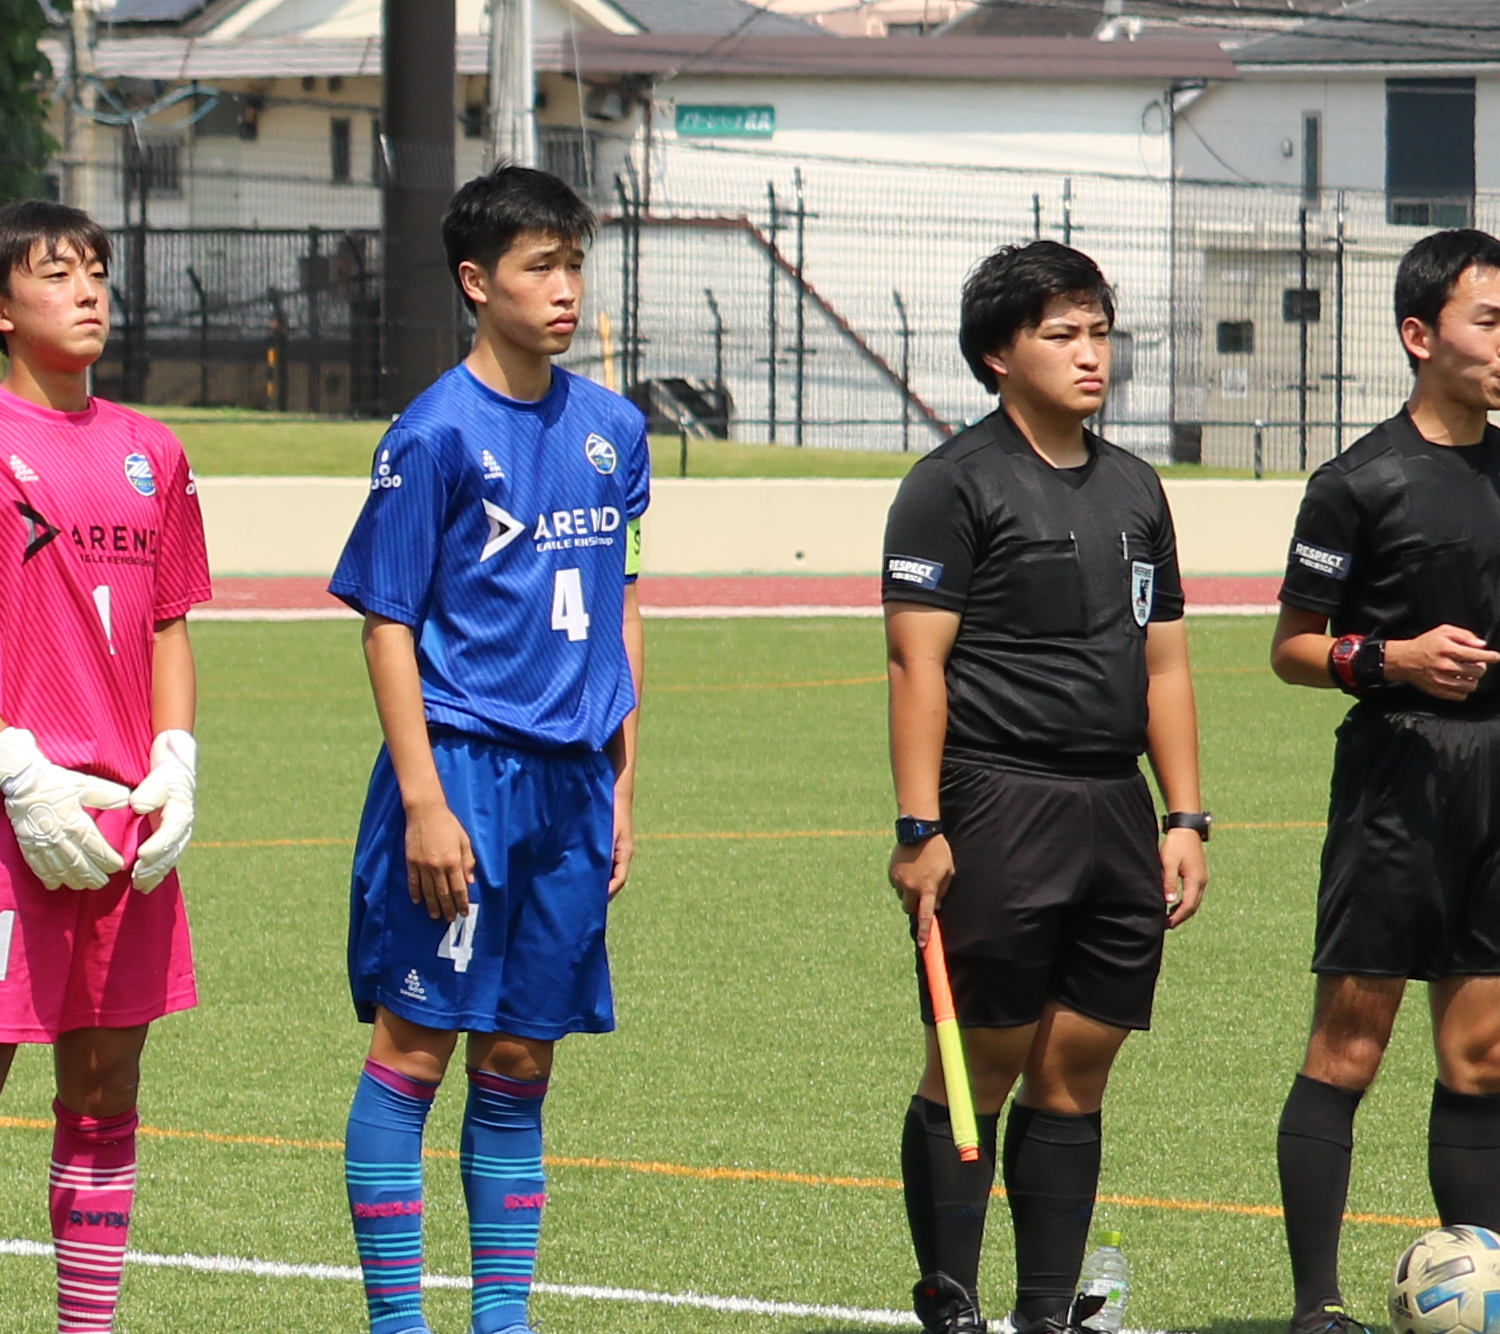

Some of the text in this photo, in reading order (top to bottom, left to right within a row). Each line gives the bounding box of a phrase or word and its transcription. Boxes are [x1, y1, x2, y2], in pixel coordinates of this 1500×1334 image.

[888, 559, 934, 577] RESPECT
[1296, 542, 1343, 568] RESPECT
[92, 585, 117, 656] 1
[550, 567, 591, 642] 4
[436, 903, 480, 973] 4
